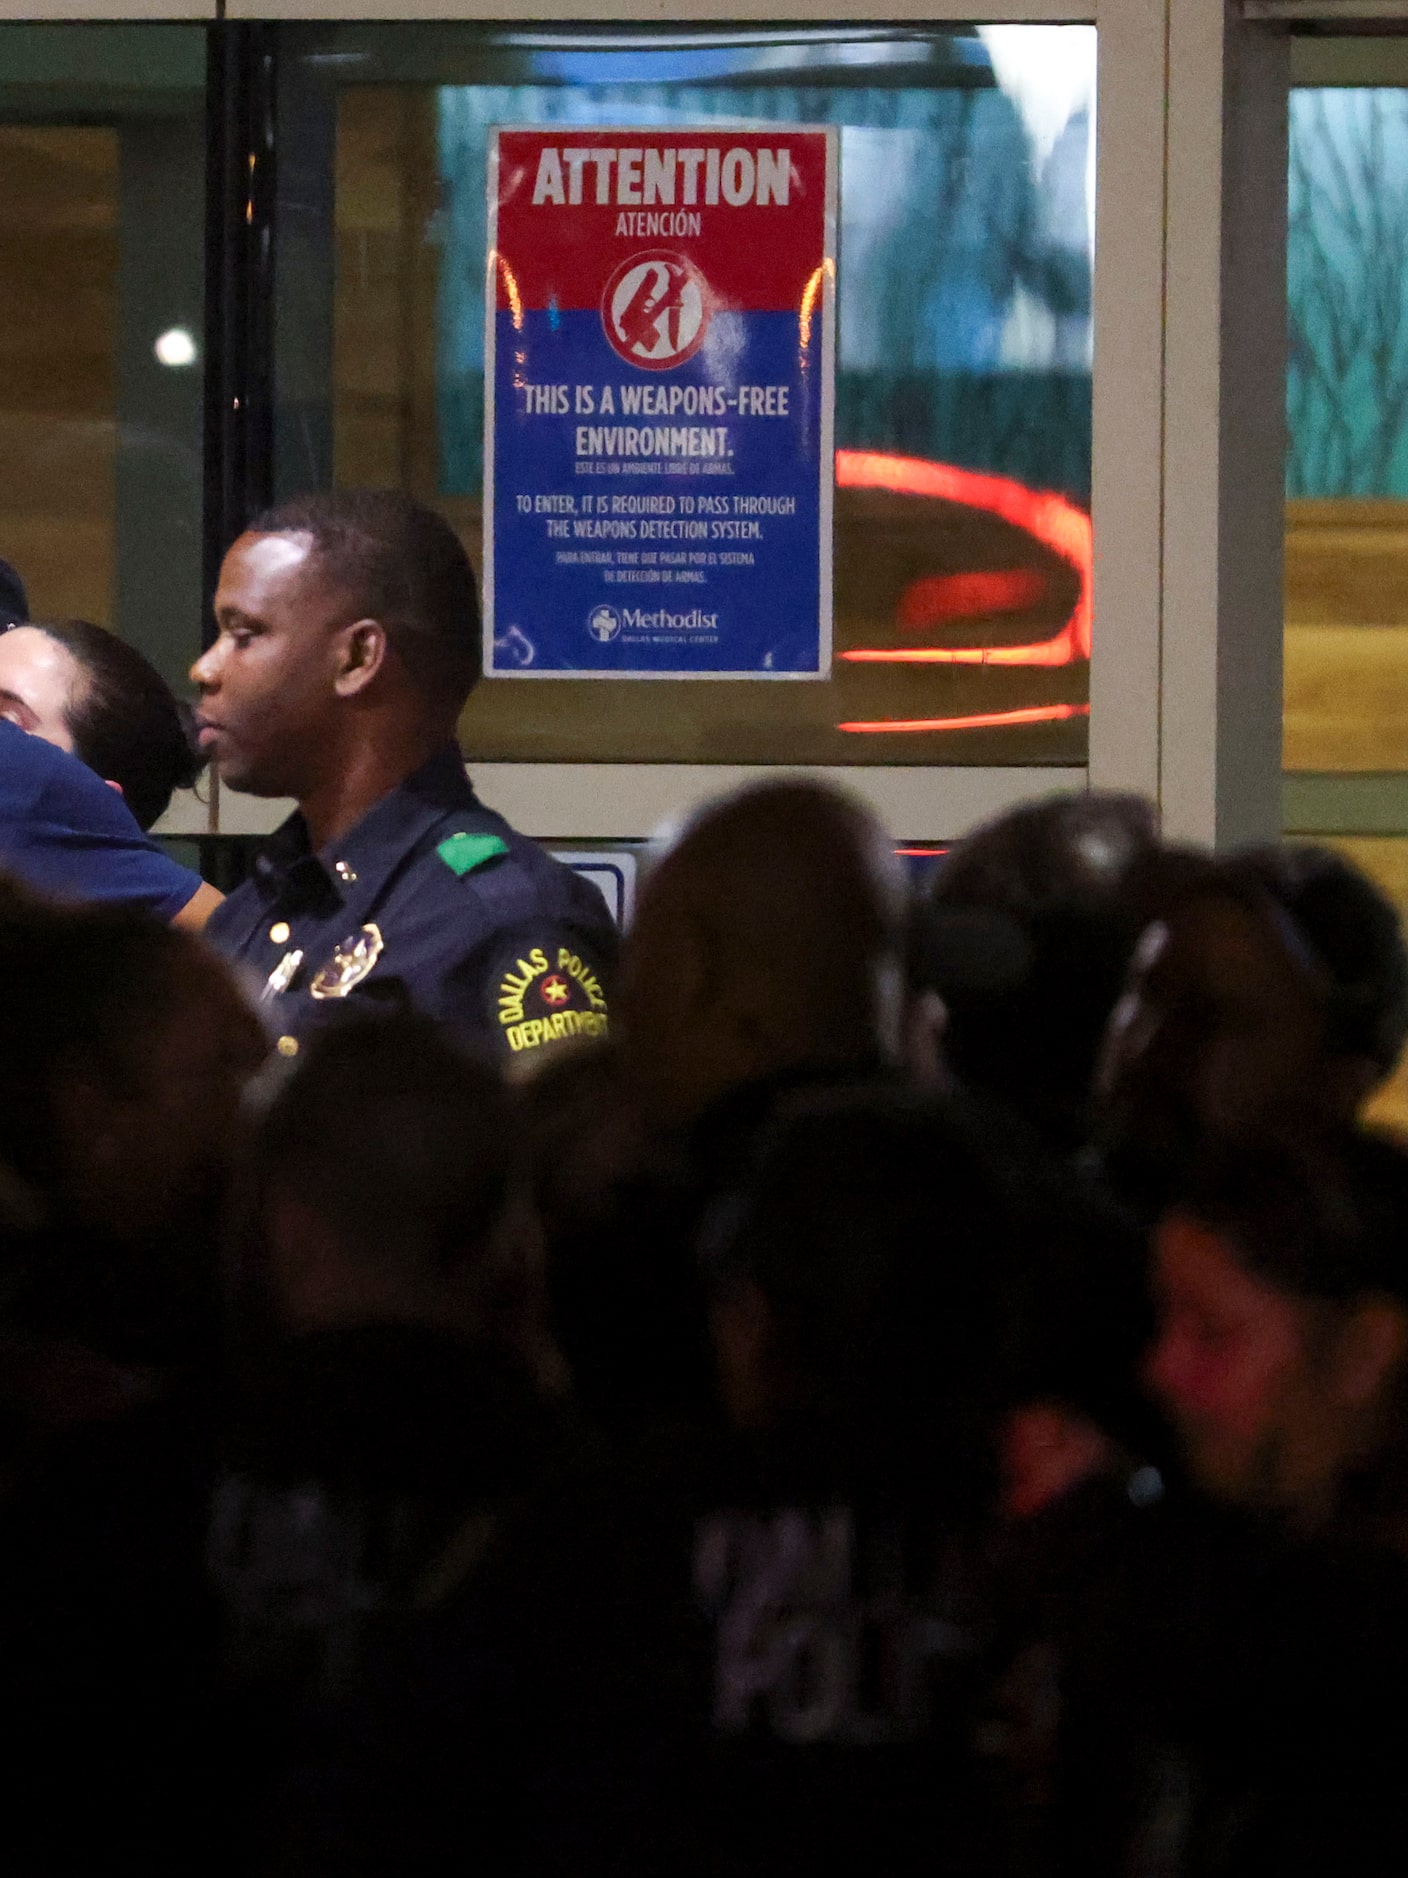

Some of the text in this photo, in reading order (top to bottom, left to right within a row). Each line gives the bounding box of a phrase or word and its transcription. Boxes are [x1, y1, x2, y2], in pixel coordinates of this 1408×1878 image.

[532, 147, 790, 206] ATTENTION
[615, 208, 701, 237] ATENCIÓN
[524, 384, 790, 415] THIS IS A WEAPONS-FREE
[576, 426, 734, 457] ENVIRONMENT.
[516, 495, 795, 516] TO ENTER, IT IS REQUIRED TO PASS THROUGH
[546, 520, 763, 539] THE WEAPONS DETECTION SYSTEM.
[622, 608, 719, 629] Methodist
[498, 948, 549, 1025] DALLAS
